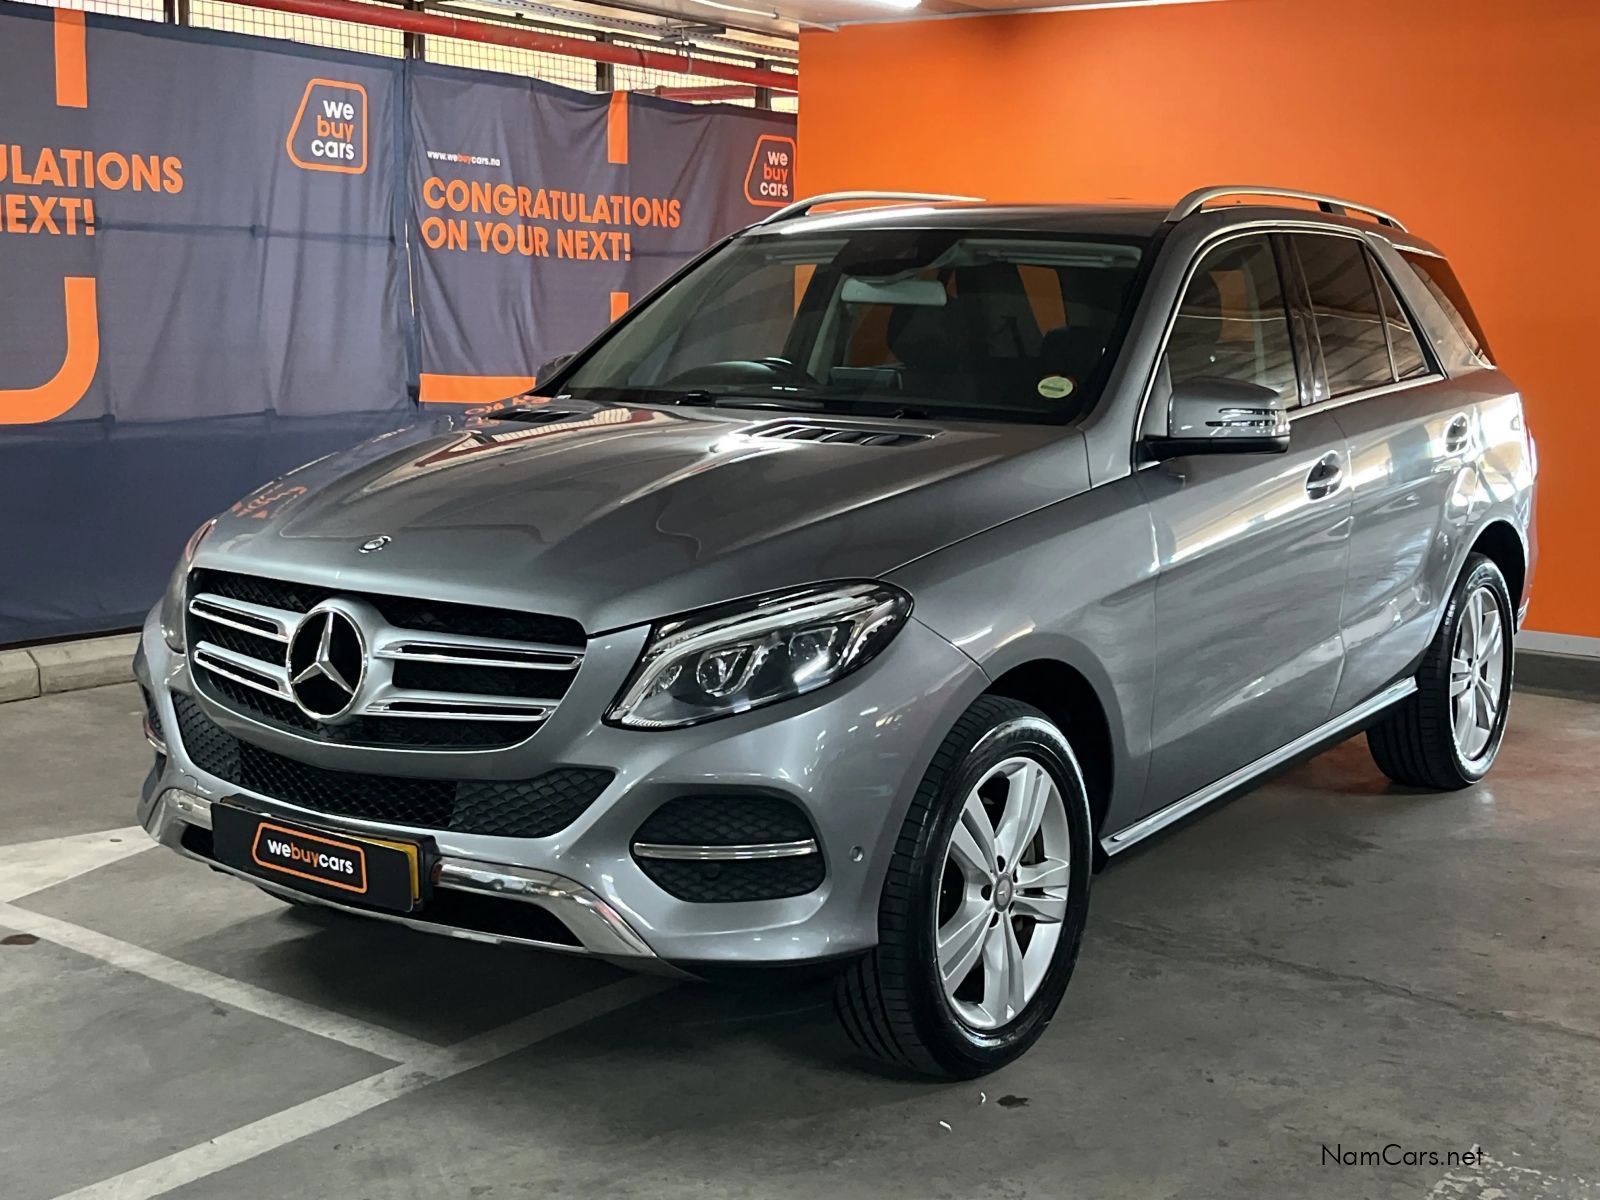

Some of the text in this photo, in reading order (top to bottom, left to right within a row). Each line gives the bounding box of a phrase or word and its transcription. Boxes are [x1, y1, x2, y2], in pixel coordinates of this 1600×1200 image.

[323, 99, 355, 120] we
[316, 115, 354, 143] buy
[311, 139, 355, 160] cars
[767, 151, 788, 166] we
[763, 162, 788, 183] buy
[760, 181, 789, 197] cars
[0, 193, 95, 236] EXT!
[423, 177, 681, 228] CONGRATULATIONS
[421, 217, 632, 262] ON YOUR NEXT!
[267, 838, 354, 875] webuycars
